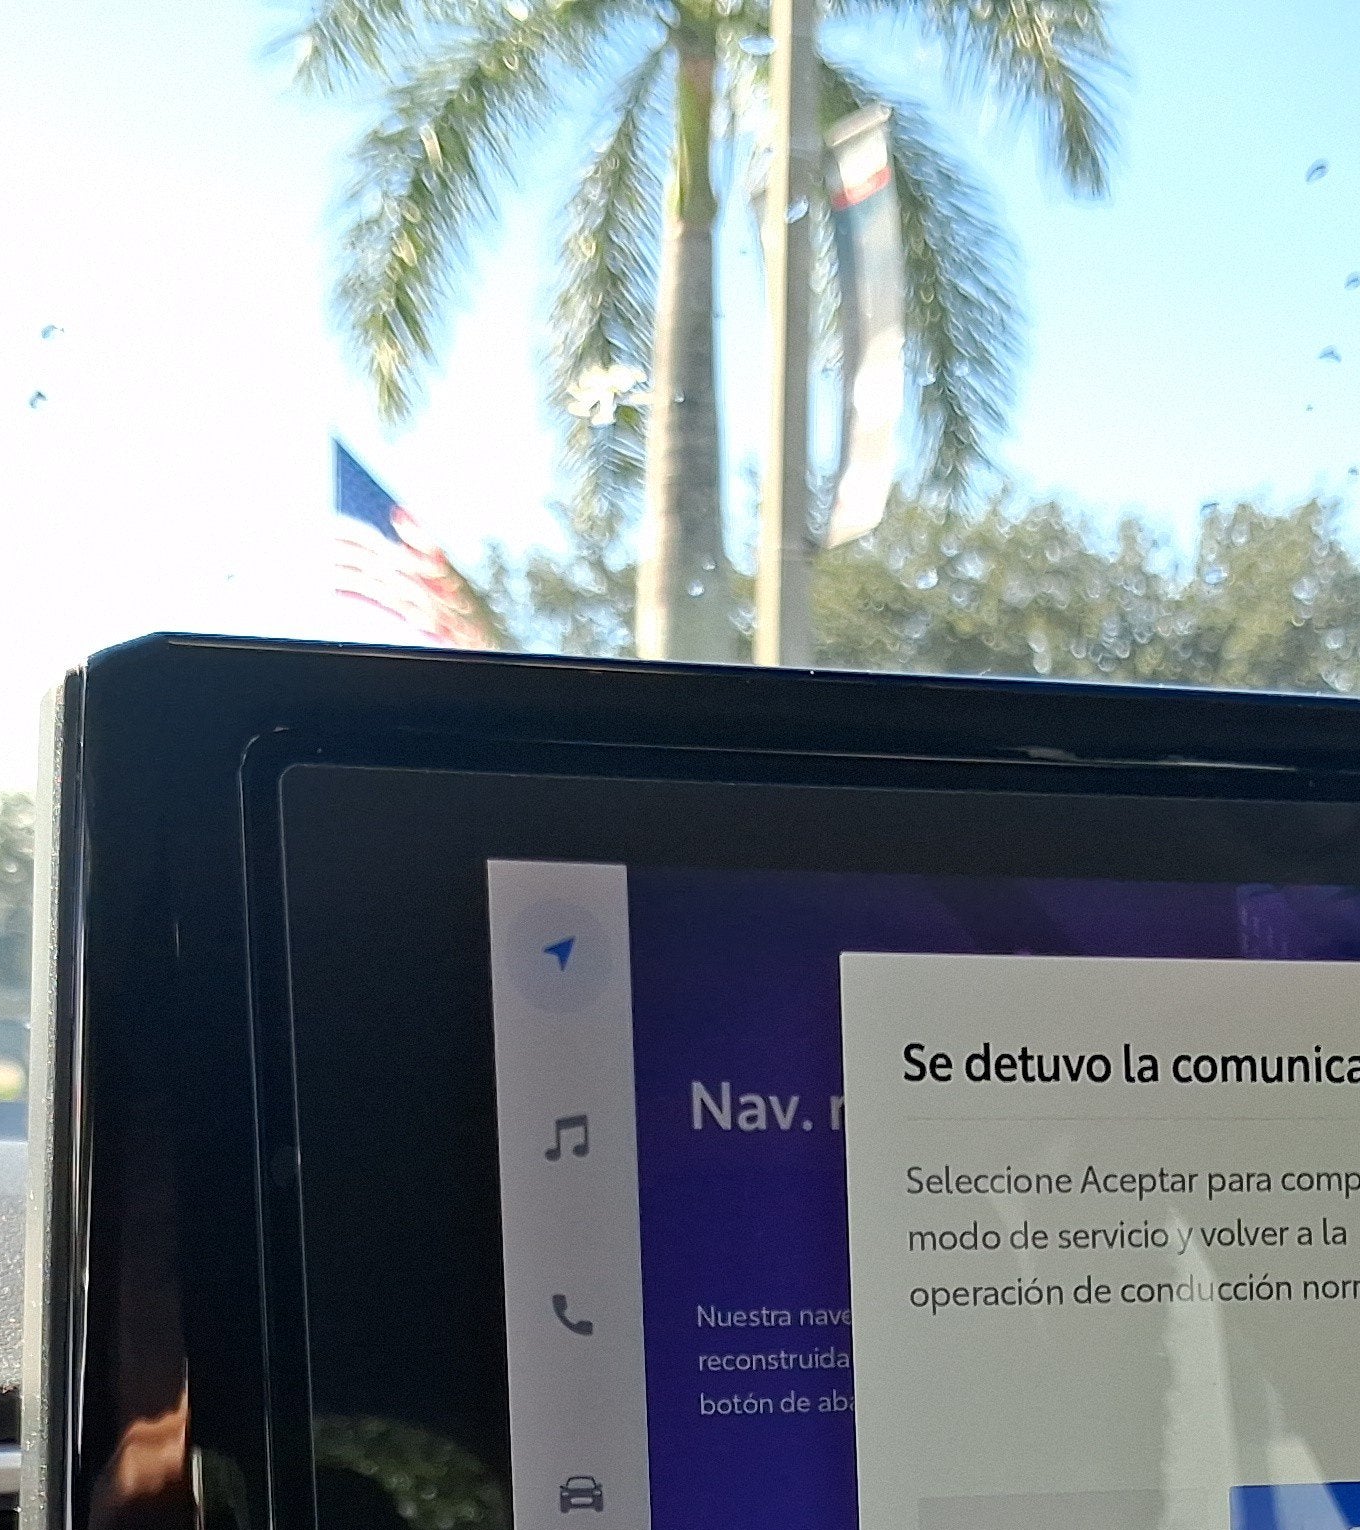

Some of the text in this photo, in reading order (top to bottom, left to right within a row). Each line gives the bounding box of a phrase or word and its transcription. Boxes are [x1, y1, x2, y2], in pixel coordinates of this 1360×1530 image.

[903, 1042, 953, 1082] Se
[965, 1042, 1111, 1083] detuvo
[1124, 1043, 1159, 1083] la
[692, 1081, 813, 1131] Nav.
[906, 1165, 1072, 1194] Seleccione
[1080, 1165, 1198, 1201] Aceptar
[1208, 1171, 1272, 1201] para
[908, 1217, 1347, 1256] modo de servicio y volver a la
[909, 1277, 1063, 1315] operación
[1073, 1275, 1111, 1304] de
[1120, 1273, 1292, 1304] conducción
[697, 1305, 791, 1328] Nuestra
[699, 1346, 850, 1371] reconstruida
[700, 1392, 773, 1415] botón
[780, 1390, 811, 1413] de
